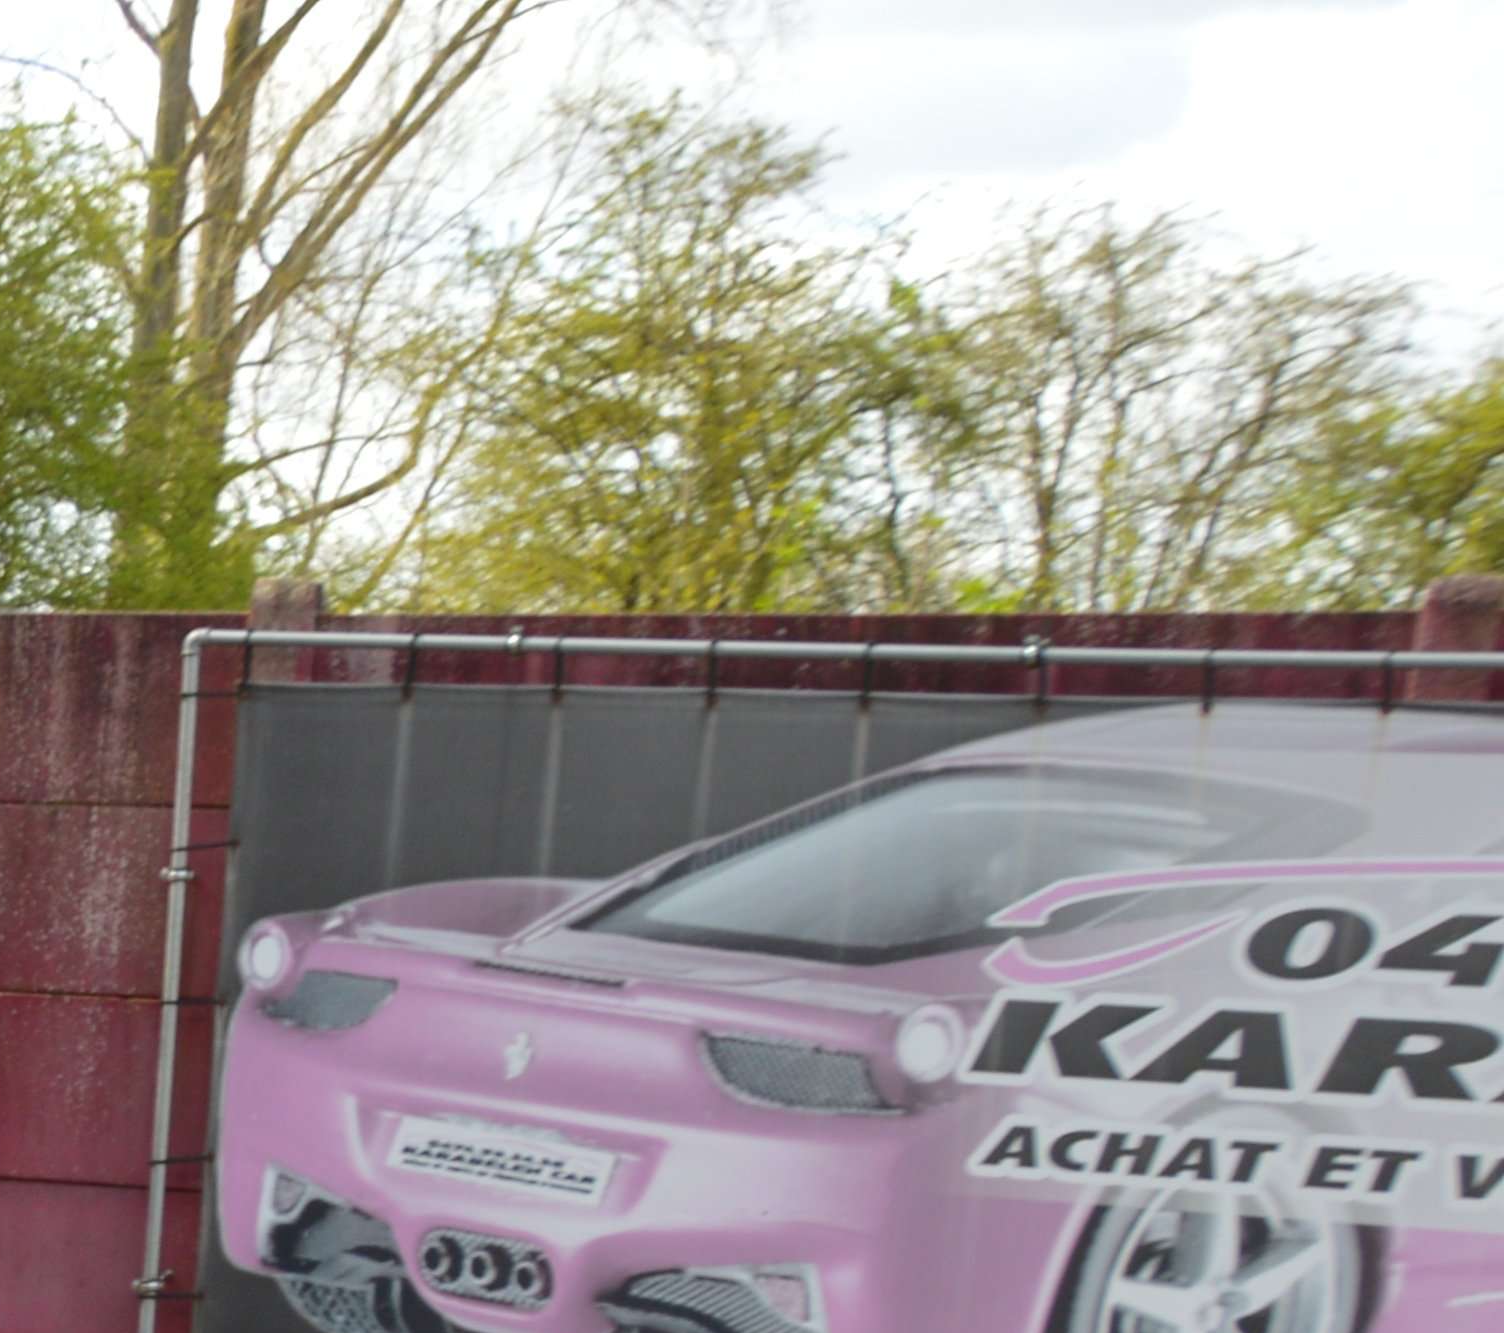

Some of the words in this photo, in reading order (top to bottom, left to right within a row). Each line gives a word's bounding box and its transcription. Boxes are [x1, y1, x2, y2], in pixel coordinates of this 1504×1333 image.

[971, 999, 1504, 1103] KAR
[979, 1126, 1282, 1184] ACHAT
[1302, 1146, 1422, 1194] ET
